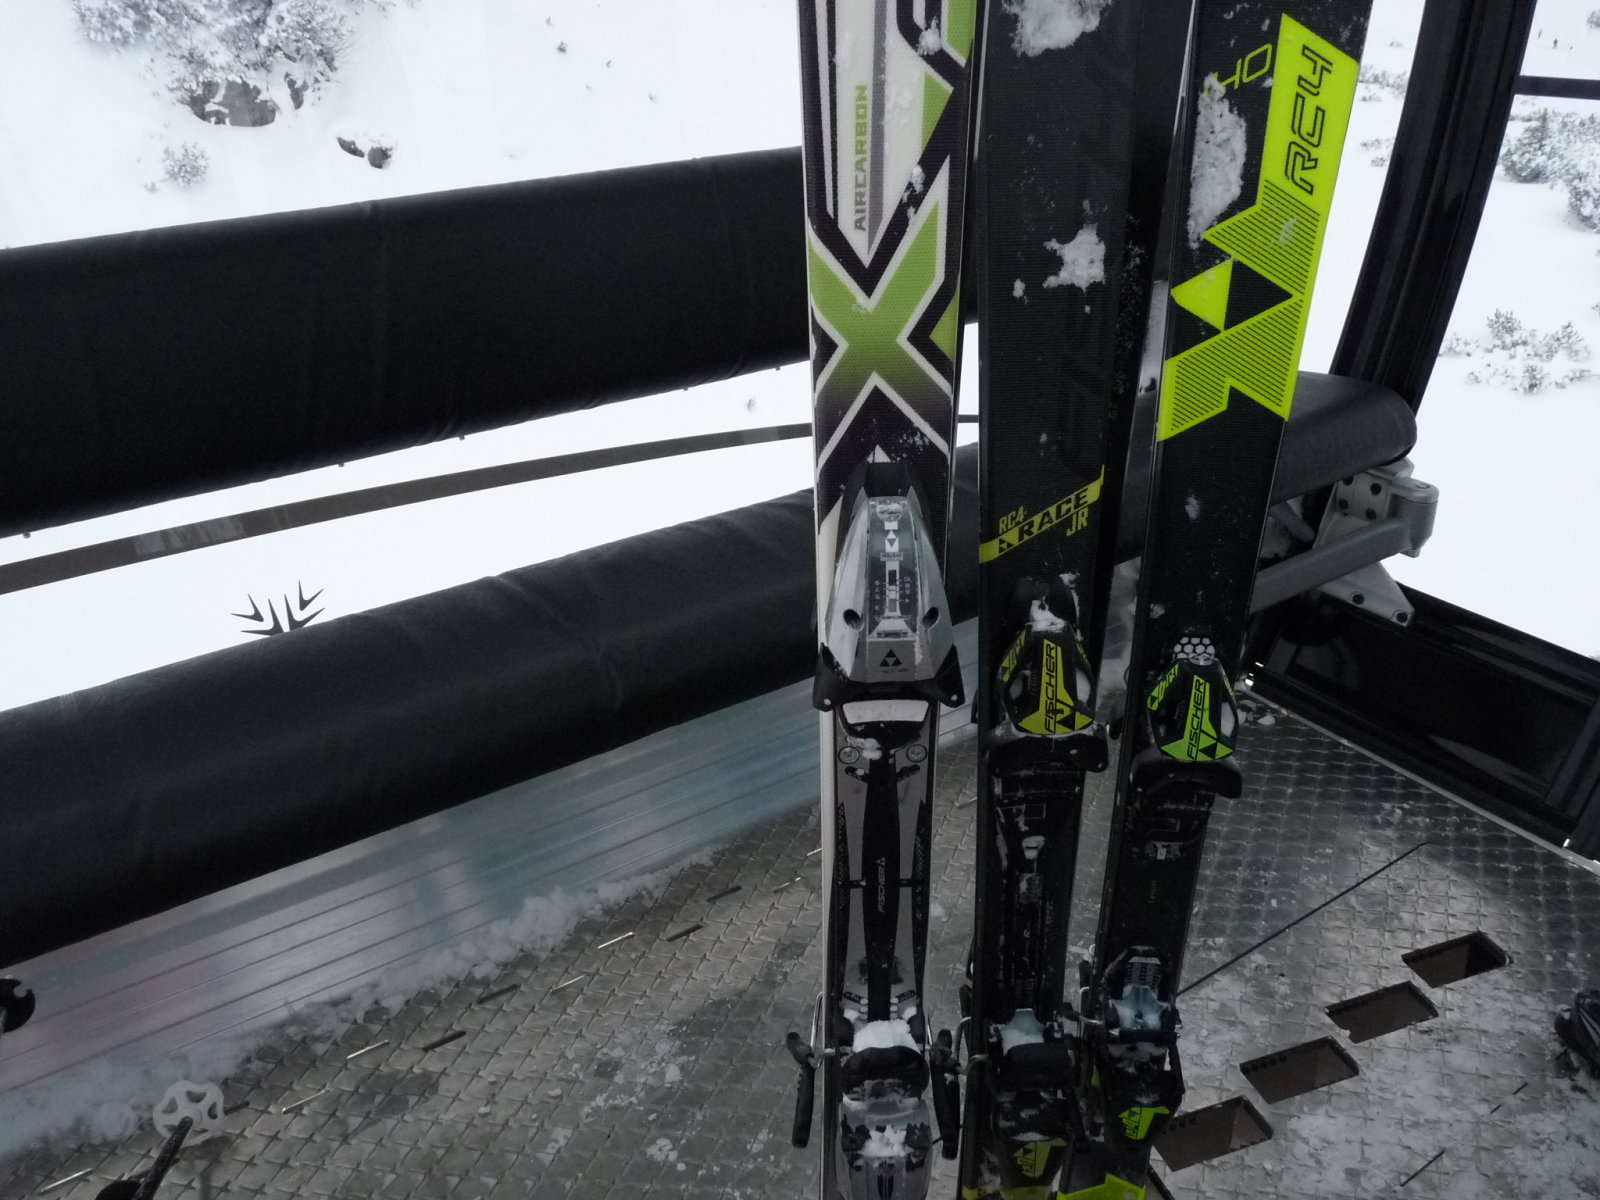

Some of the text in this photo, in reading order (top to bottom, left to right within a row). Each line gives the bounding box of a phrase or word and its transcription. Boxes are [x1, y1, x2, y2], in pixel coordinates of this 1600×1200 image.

[1285, 44, 1333, 196] RC4
[854, 85, 868, 231] AIRCARBON
[998, 505, 1025, 535] RC4
[1018, 487, 1089, 542] RACE
[1065, 507, 1089, 537] JR
[1044, 643, 1057, 734] FISCHER
[1186, 678, 1205, 761] FISCHER
[877, 865, 885, 913] FISCHER
